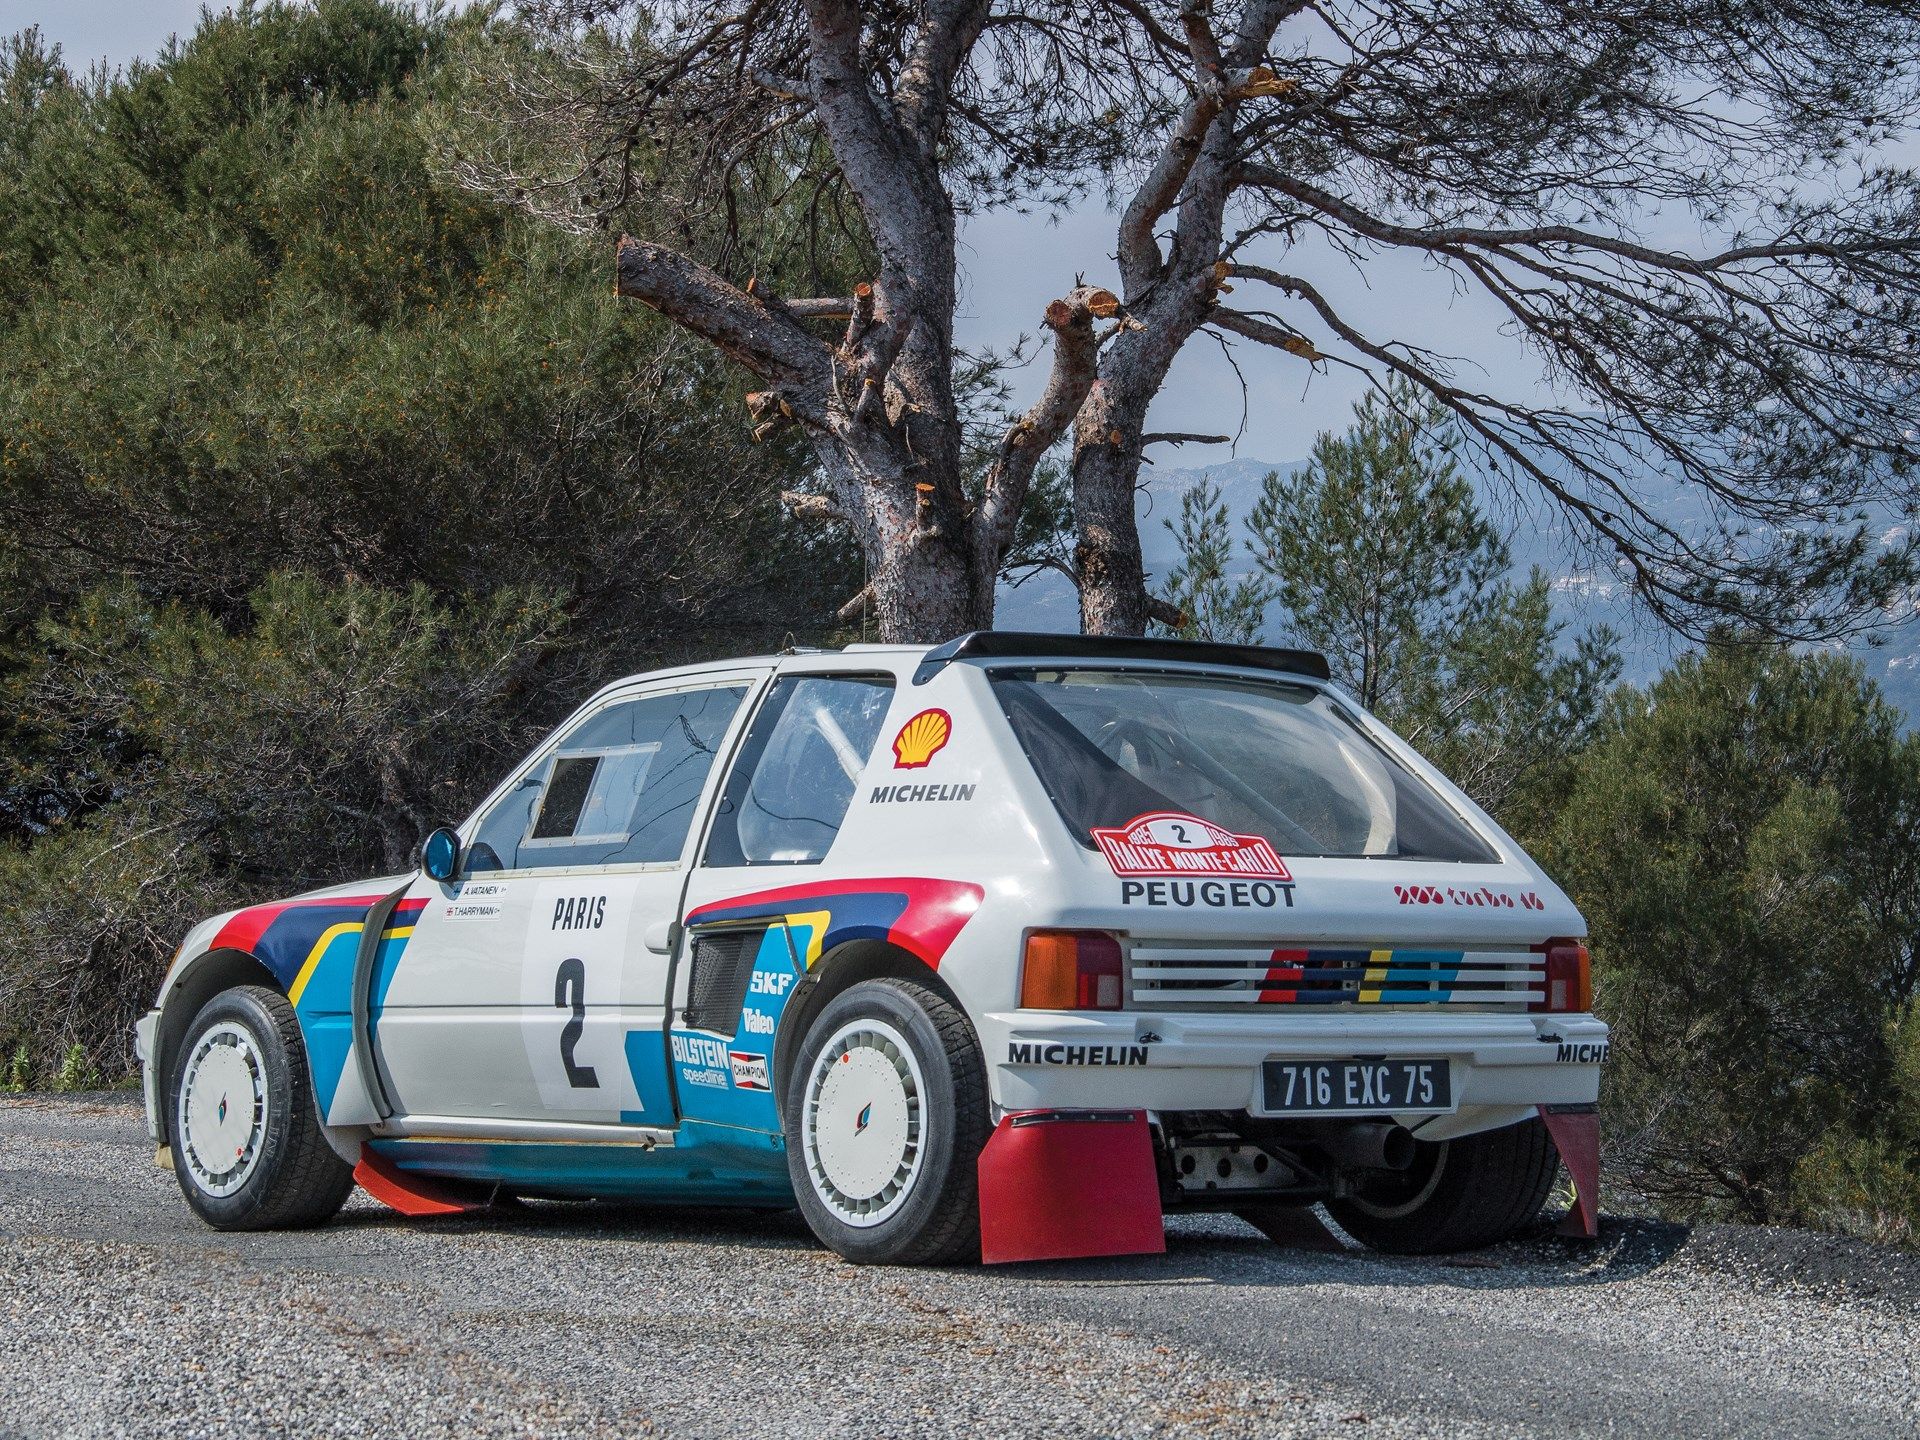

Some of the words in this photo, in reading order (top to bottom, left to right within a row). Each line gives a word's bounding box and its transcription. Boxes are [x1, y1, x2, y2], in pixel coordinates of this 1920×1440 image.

[869, 784, 977, 804] MICHELIN
[1127, 824, 1156, 846] 1985
[1170, 824, 1192, 844] 2
[1103, 836, 1172, 870] RALLYE
[1167, 843, 1280, 874] MONTE-CARLO
[1121, 881, 1296, 908] PEUGEOT
[1393, 885, 1445, 905] 205
[1447, 887, 1515, 908] turbo
[1520, 892, 1545, 911] 16
[551, 896, 607, 931] PARIS
[750, 970, 794, 996] SKF
[554, 957, 601, 1089] 2
[742, 1007, 775, 1035] Valeo
[670, 1034, 730, 1070] BILSTEIN
[1008, 1042, 1149, 1066] MICHELIN
[733, 1063, 768, 1080] CHAMPION
[1282, 1066, 1331, 1106] 716
[1343, 1065, 1391, 1105] EXC
[1403, 1065, 1434, 1104] 75
